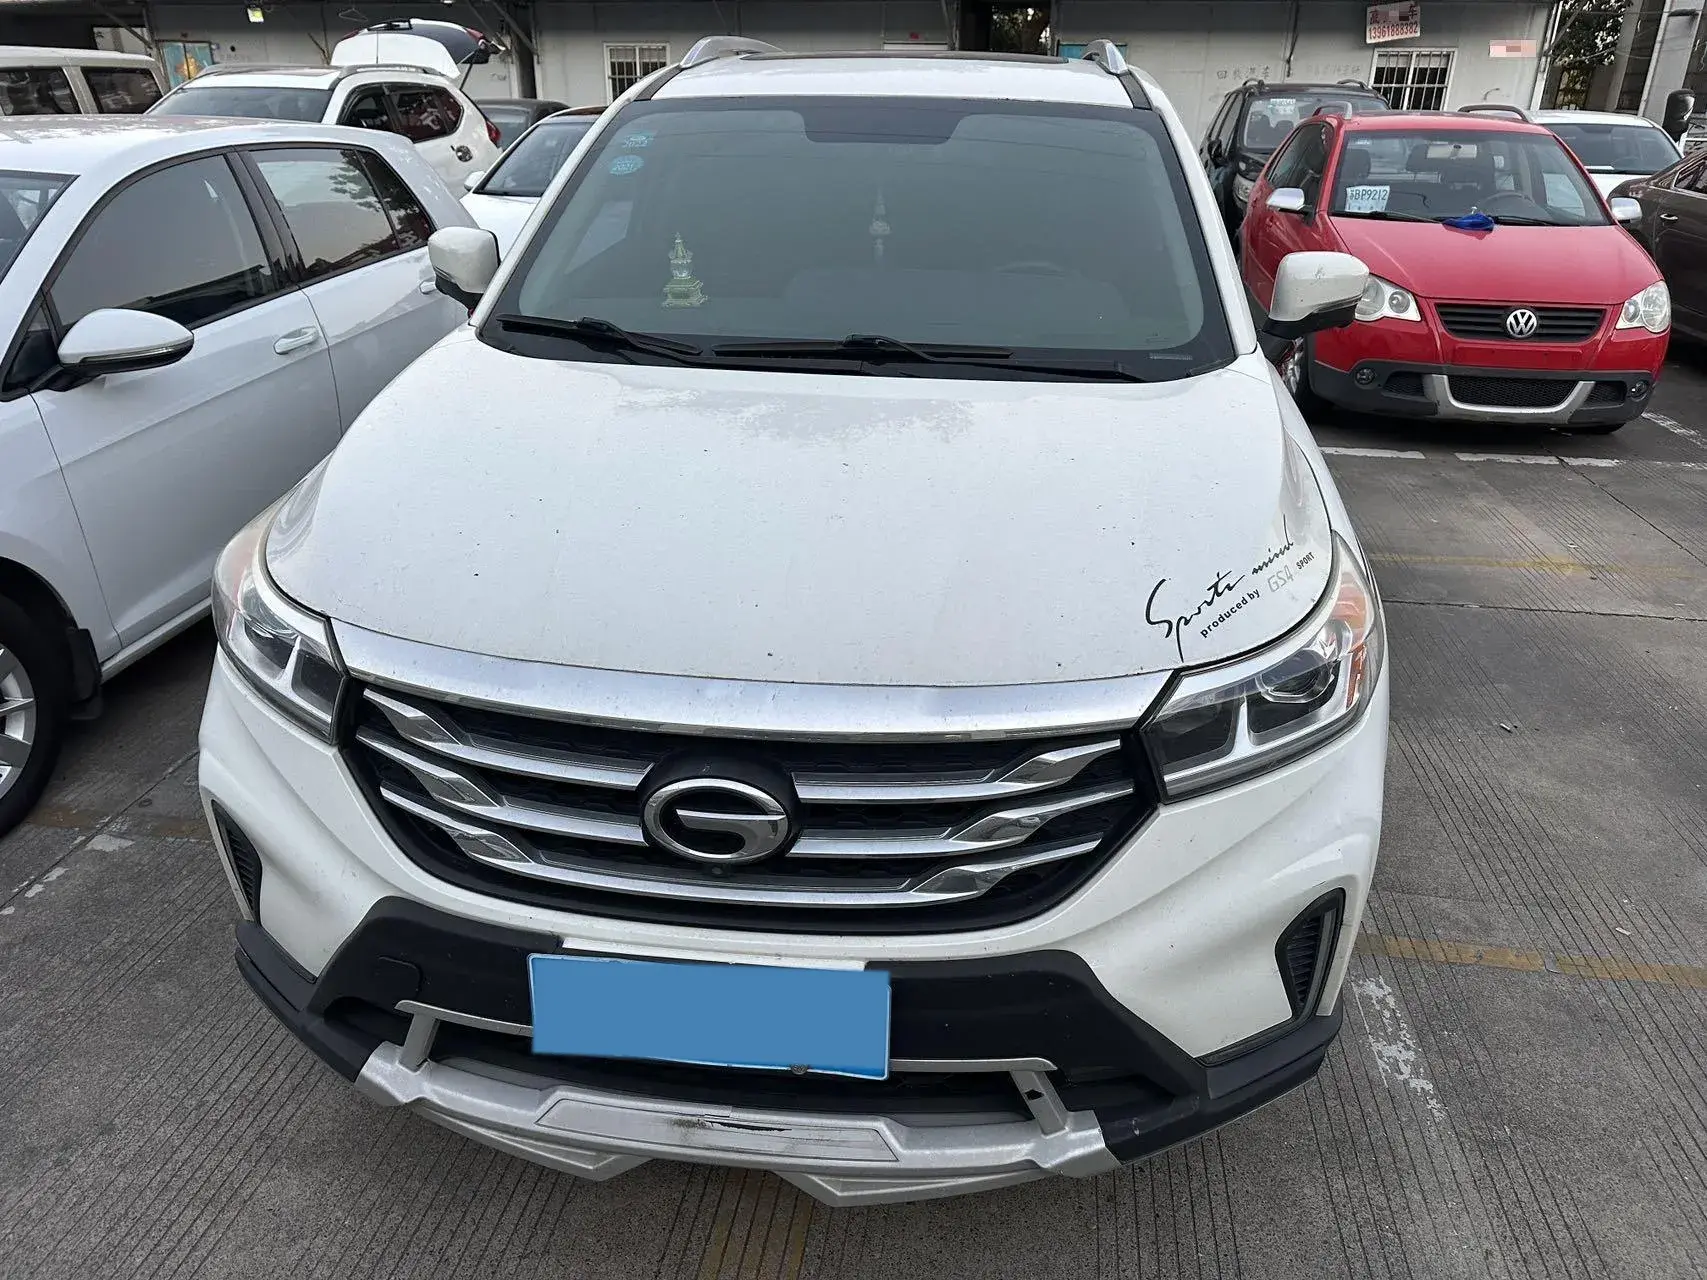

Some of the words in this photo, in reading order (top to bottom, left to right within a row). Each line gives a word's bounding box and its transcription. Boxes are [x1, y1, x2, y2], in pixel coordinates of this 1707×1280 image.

[1368, 20, 1418, 39] 13961888382
[1200, 597, 1249, 639] produced
[1246, 588, 1261, 600] by
[1267, 564, 1295, 592] GS4
[1296, 551, 1316, 571] SPORT
